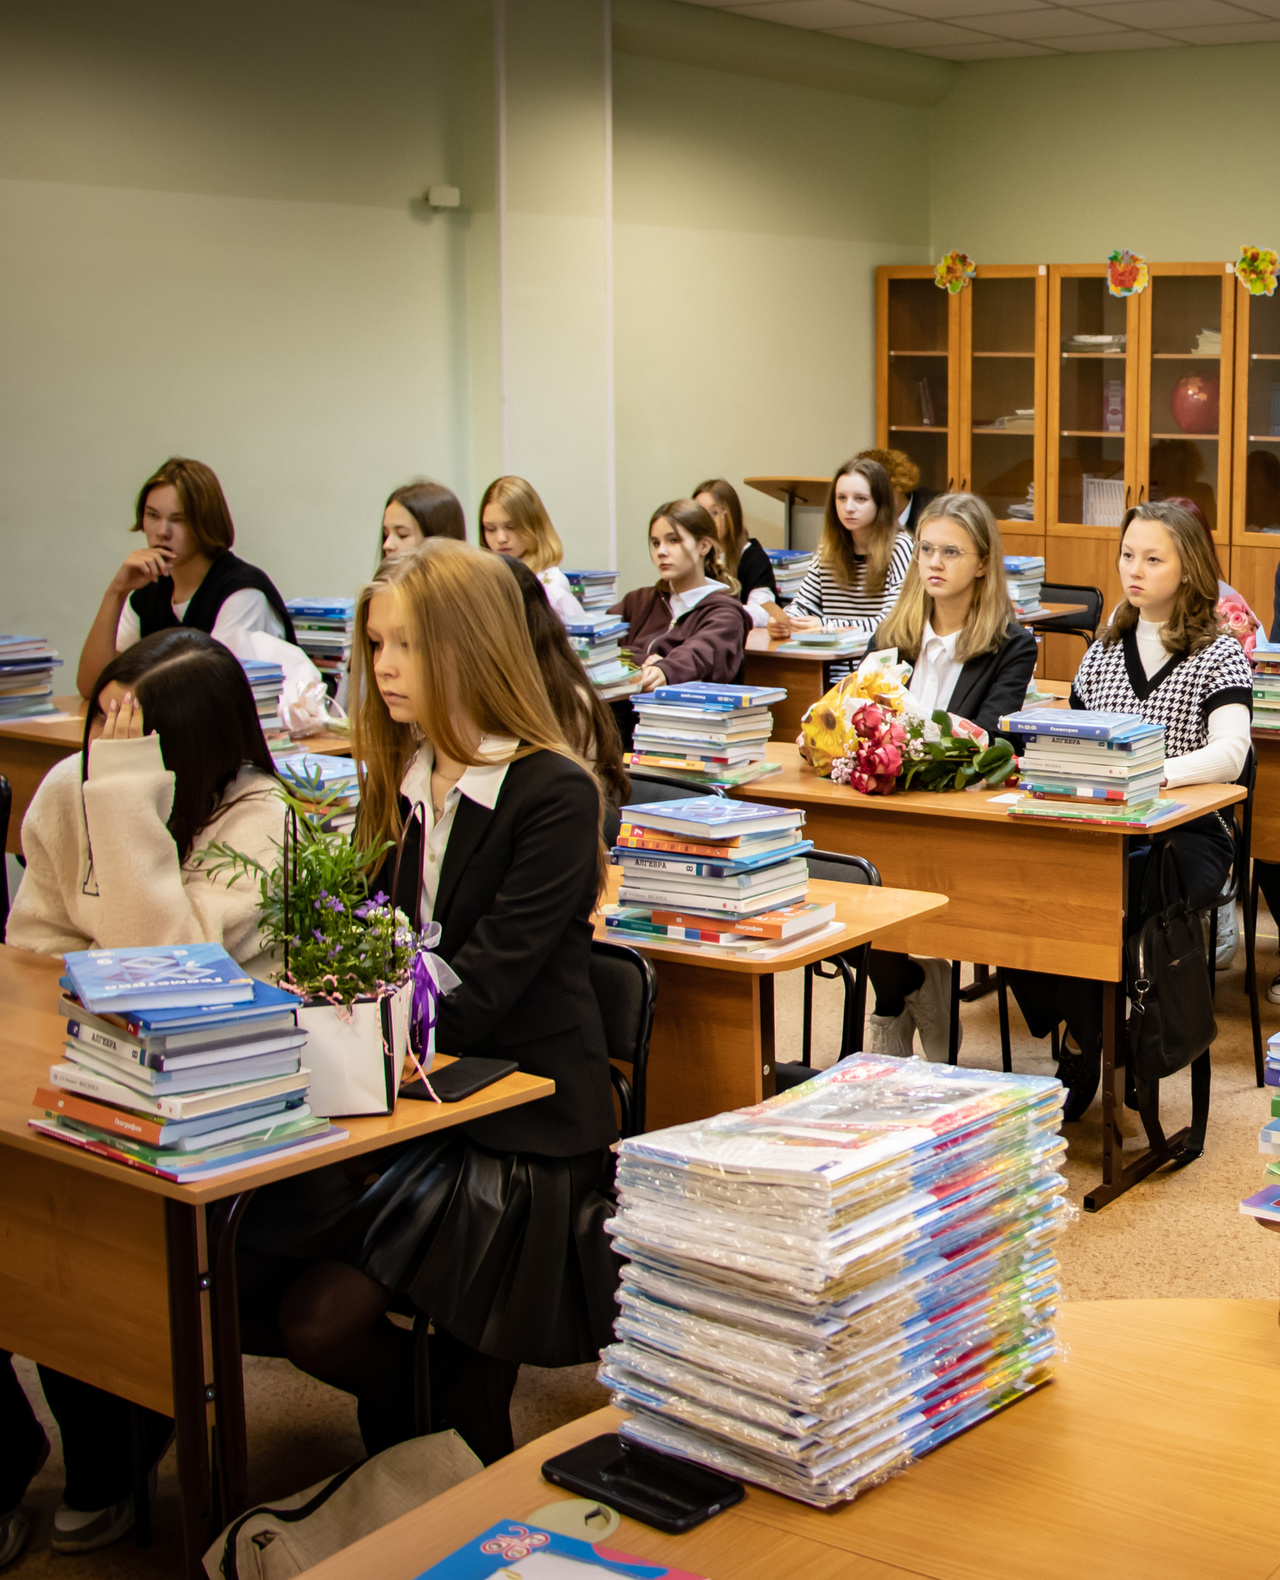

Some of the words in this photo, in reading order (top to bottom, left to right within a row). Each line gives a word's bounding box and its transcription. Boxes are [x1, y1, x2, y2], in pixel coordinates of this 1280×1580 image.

[1050, 726, 1079, 734] Геометрия
[1051, 737, 1081, 745] АЛГЕБРА
[635, 858, 667, 869] АЛГЕБРА
[734, 923, 764, 933] География
[91, 1032, 117, 1051] АЛГЕБРА
[114, 1117, 143, 1133] География
